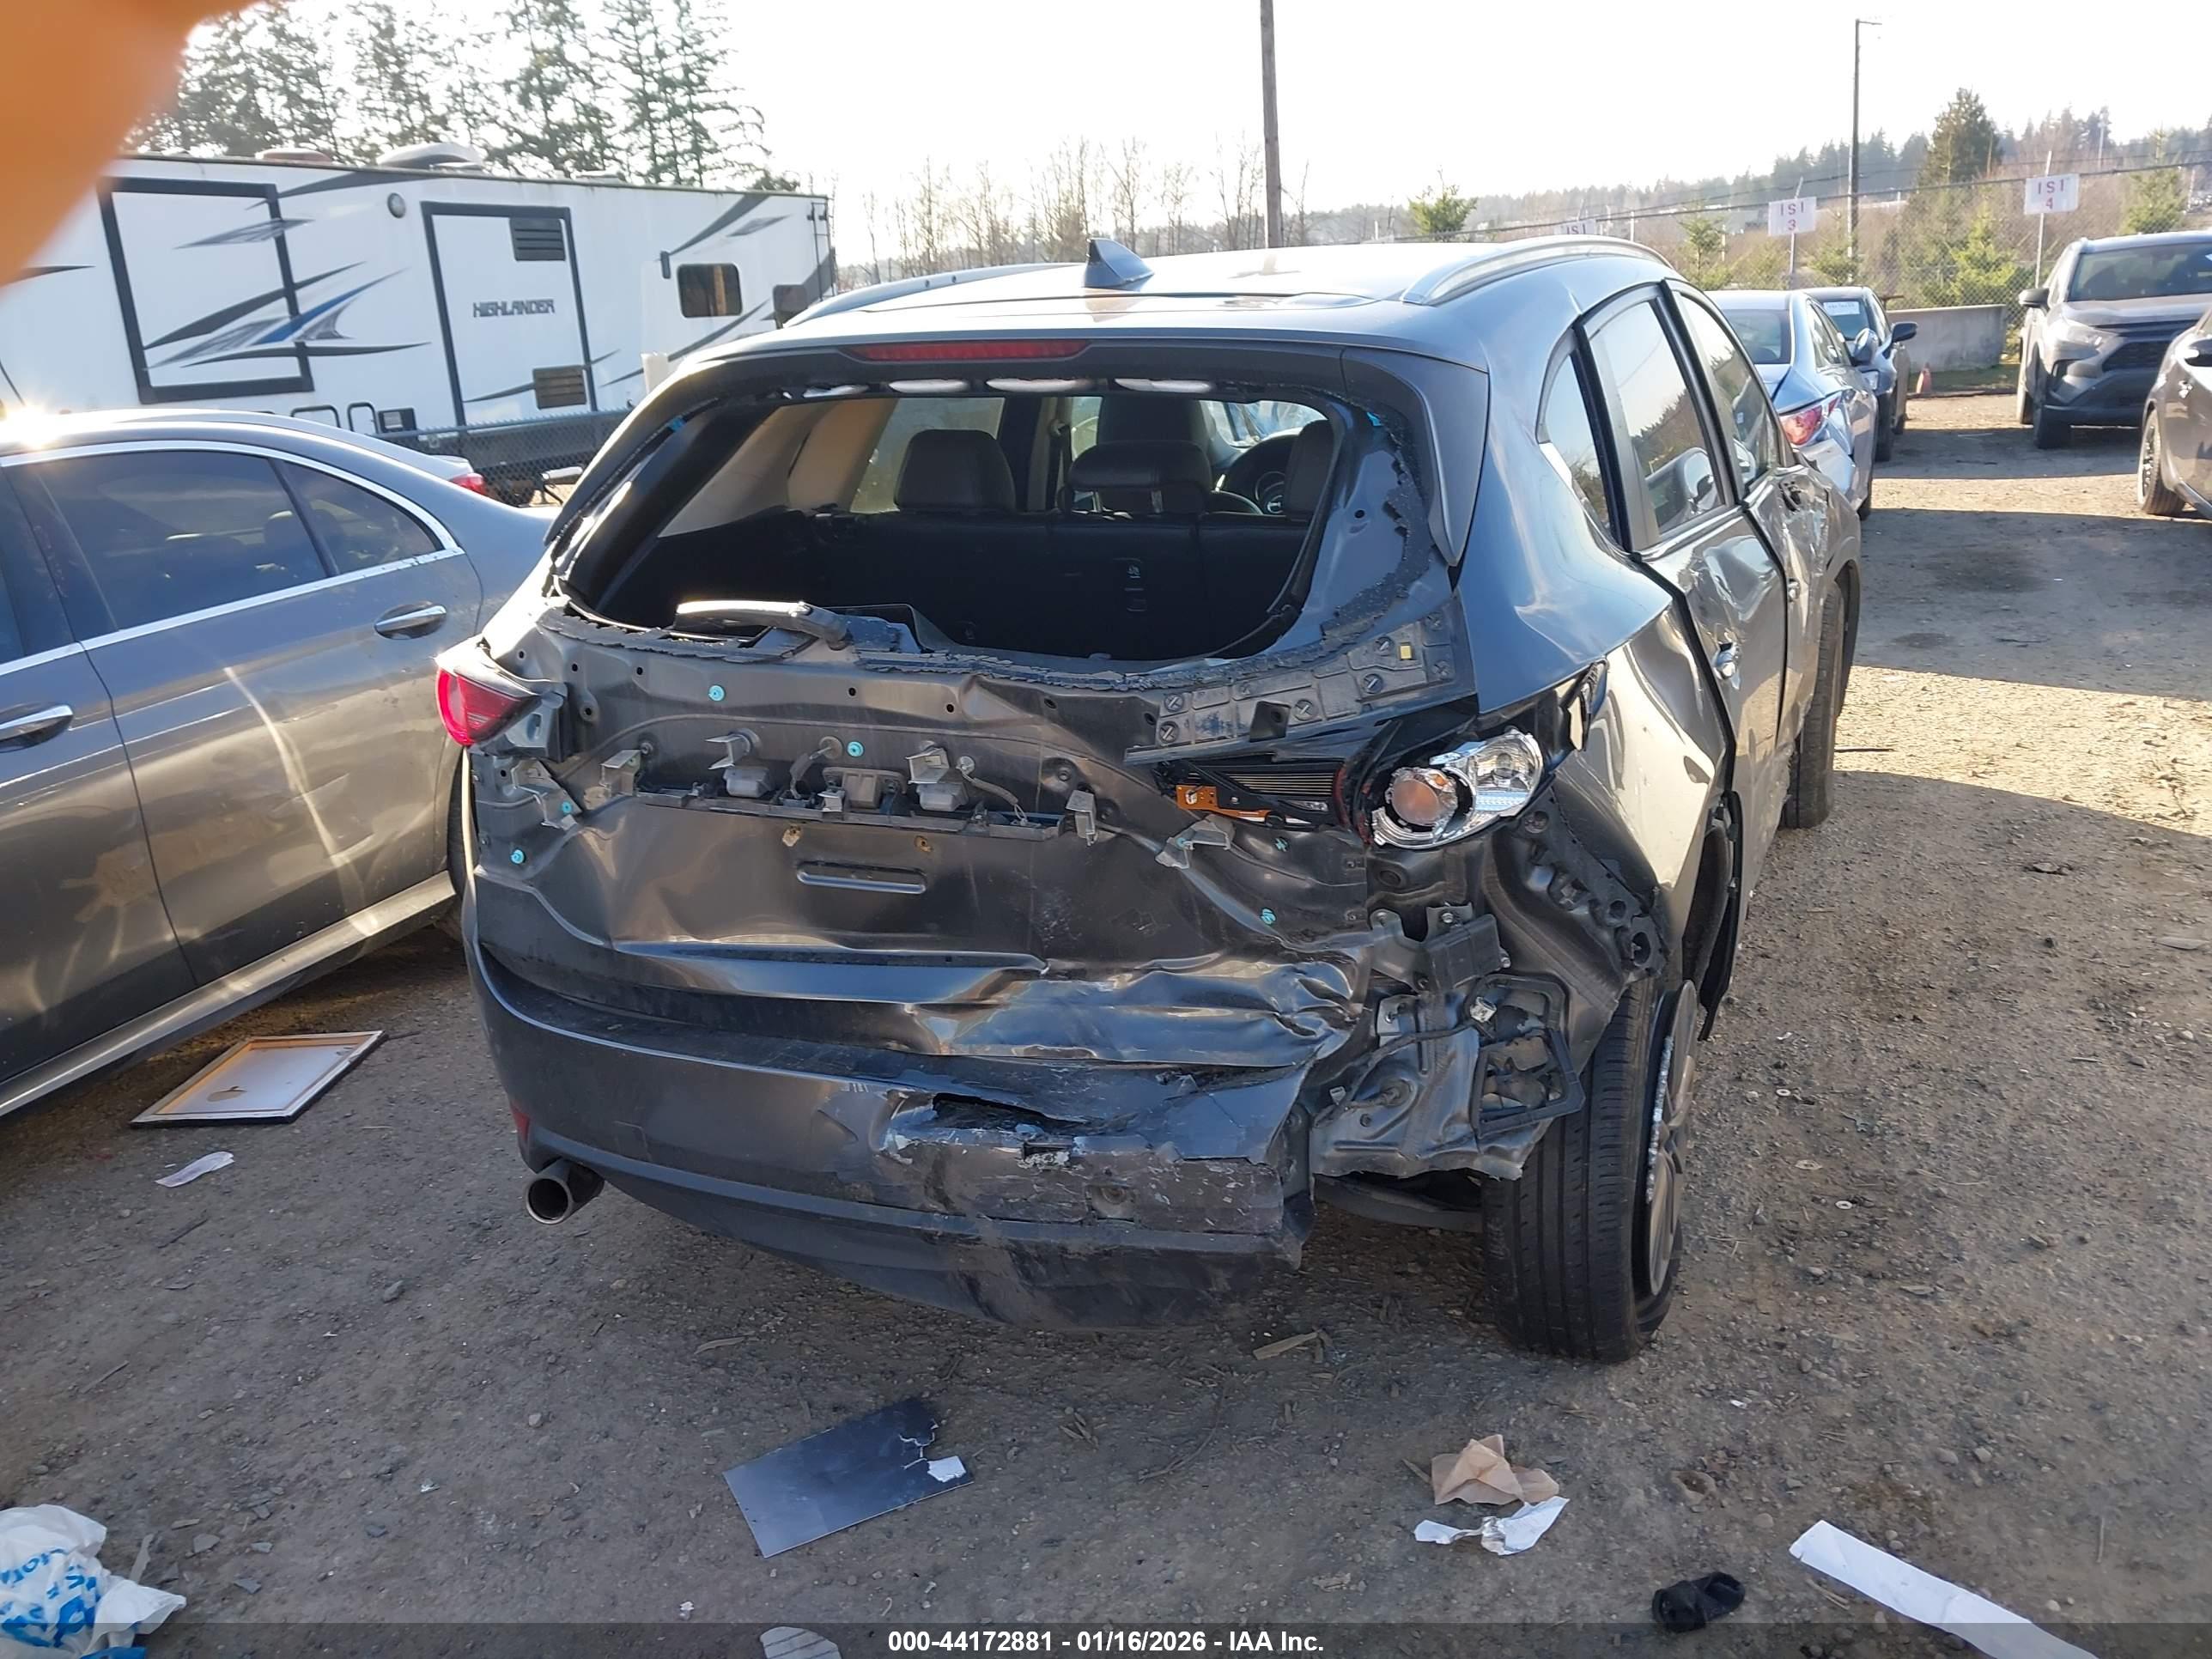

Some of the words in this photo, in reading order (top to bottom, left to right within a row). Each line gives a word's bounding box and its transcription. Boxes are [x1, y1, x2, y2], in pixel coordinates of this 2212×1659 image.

[2045, 197, 2053, 210] 4
[1788, 218, 1796, 231] 3
[473, 299, 556, 318] HIGHLANDER
